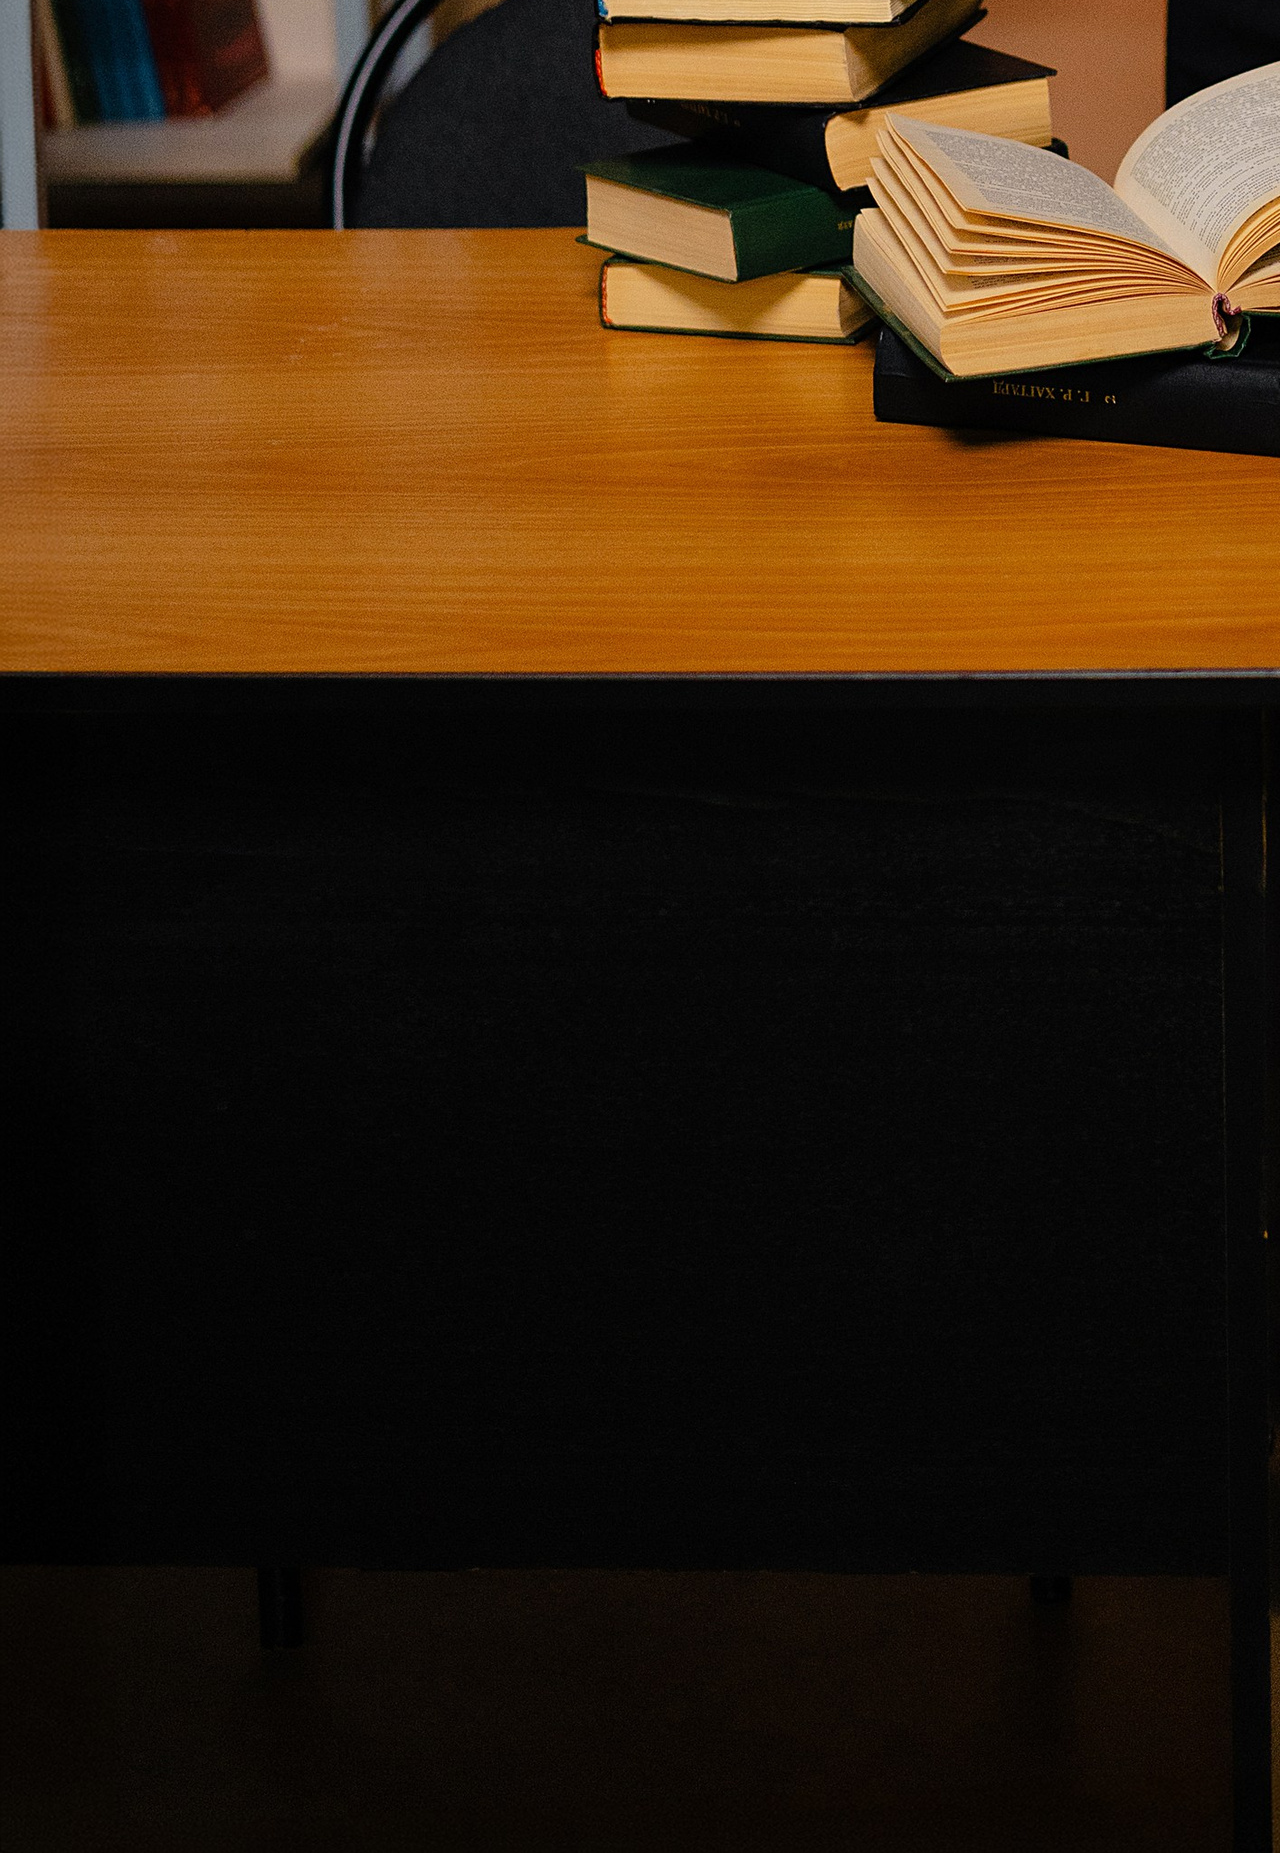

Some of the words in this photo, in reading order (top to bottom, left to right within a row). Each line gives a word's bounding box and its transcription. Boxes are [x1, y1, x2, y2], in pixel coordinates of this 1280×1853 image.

[992, 379, 1056, 400] ХАГГАРД
[1060, 388, 1073, 402] Р.
[1078, 389, 1090, 403] Г.
